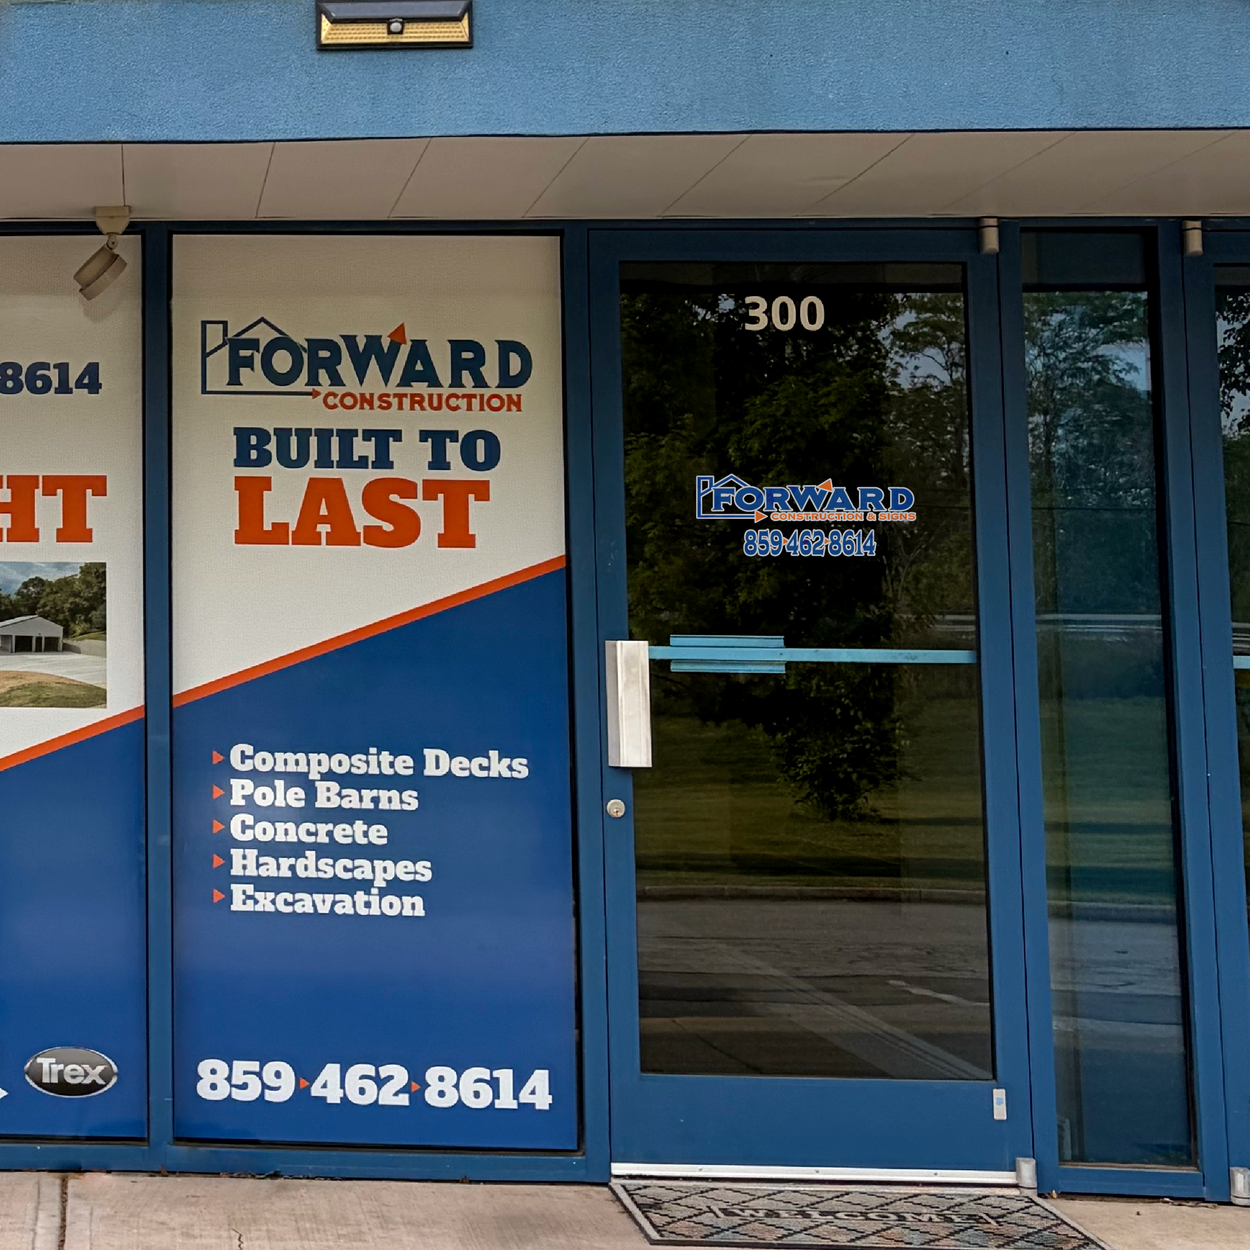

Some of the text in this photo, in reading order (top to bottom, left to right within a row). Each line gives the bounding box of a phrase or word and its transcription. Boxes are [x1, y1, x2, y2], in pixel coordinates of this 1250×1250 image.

[743, 295, 825, 332] 300
[225, 334, 533, 389] FORWARD
[322, 391, 523, 412] CONSTRUCTION
[233, 426, 502, 472] BUILT TO
[233, 475, 491, 549] LAST
[711, 485, 915, 513] FORWARD
[770, 511, 917, 522] CONSTRUCTION & SIGNS
[229, 743, 530, 780] Composite Decks
[229, 778, 419, 811] Pole Barns
[229, 813, 389, 845] Concrete
[229, 848, 433, 887] Hardscapes
[230, 883, 426, 917] Excavation
[36, 1057, 107, 1086] Trex
